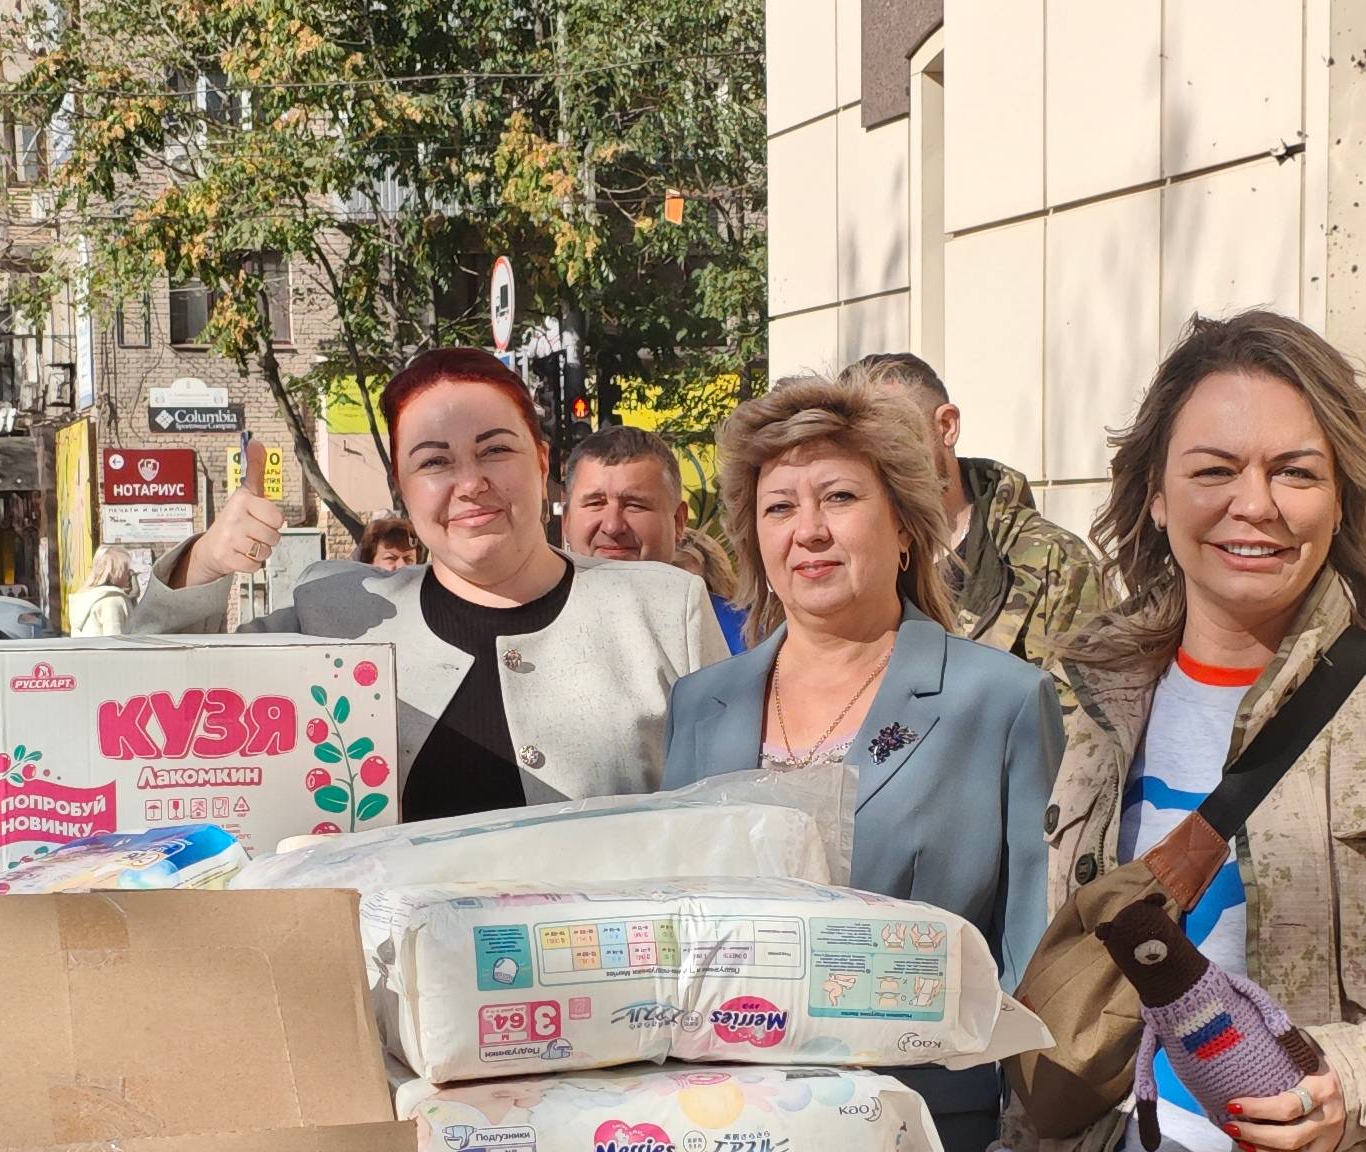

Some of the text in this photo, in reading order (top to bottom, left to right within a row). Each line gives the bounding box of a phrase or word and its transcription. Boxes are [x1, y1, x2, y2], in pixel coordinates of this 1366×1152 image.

[174, 409, 238, 424] Columbia
[112, 483, 186, 497] НОТАРИУС
[14, 678, 72, 689] РУССКАРТ
[96, 687, 298, 761] КУЗЯ
[137, 765, 262, 789] Лакомкин
[0, 794, 107, 818] ПОПРОБУЙ
[1, 816, 93, 839] НОВИНКУ
[493, 1013, 525, 1030] 64
[536, 1006, 556, 1036] 3
[709, 1009, 789, 1032] Merries
[912, 1039, 942, 1049] kao
[484, 1046, 541, 1059] Подгузники
[839, 1103, 870, 1116] kao
[475, 1131, 531, 1145] Подгузники
